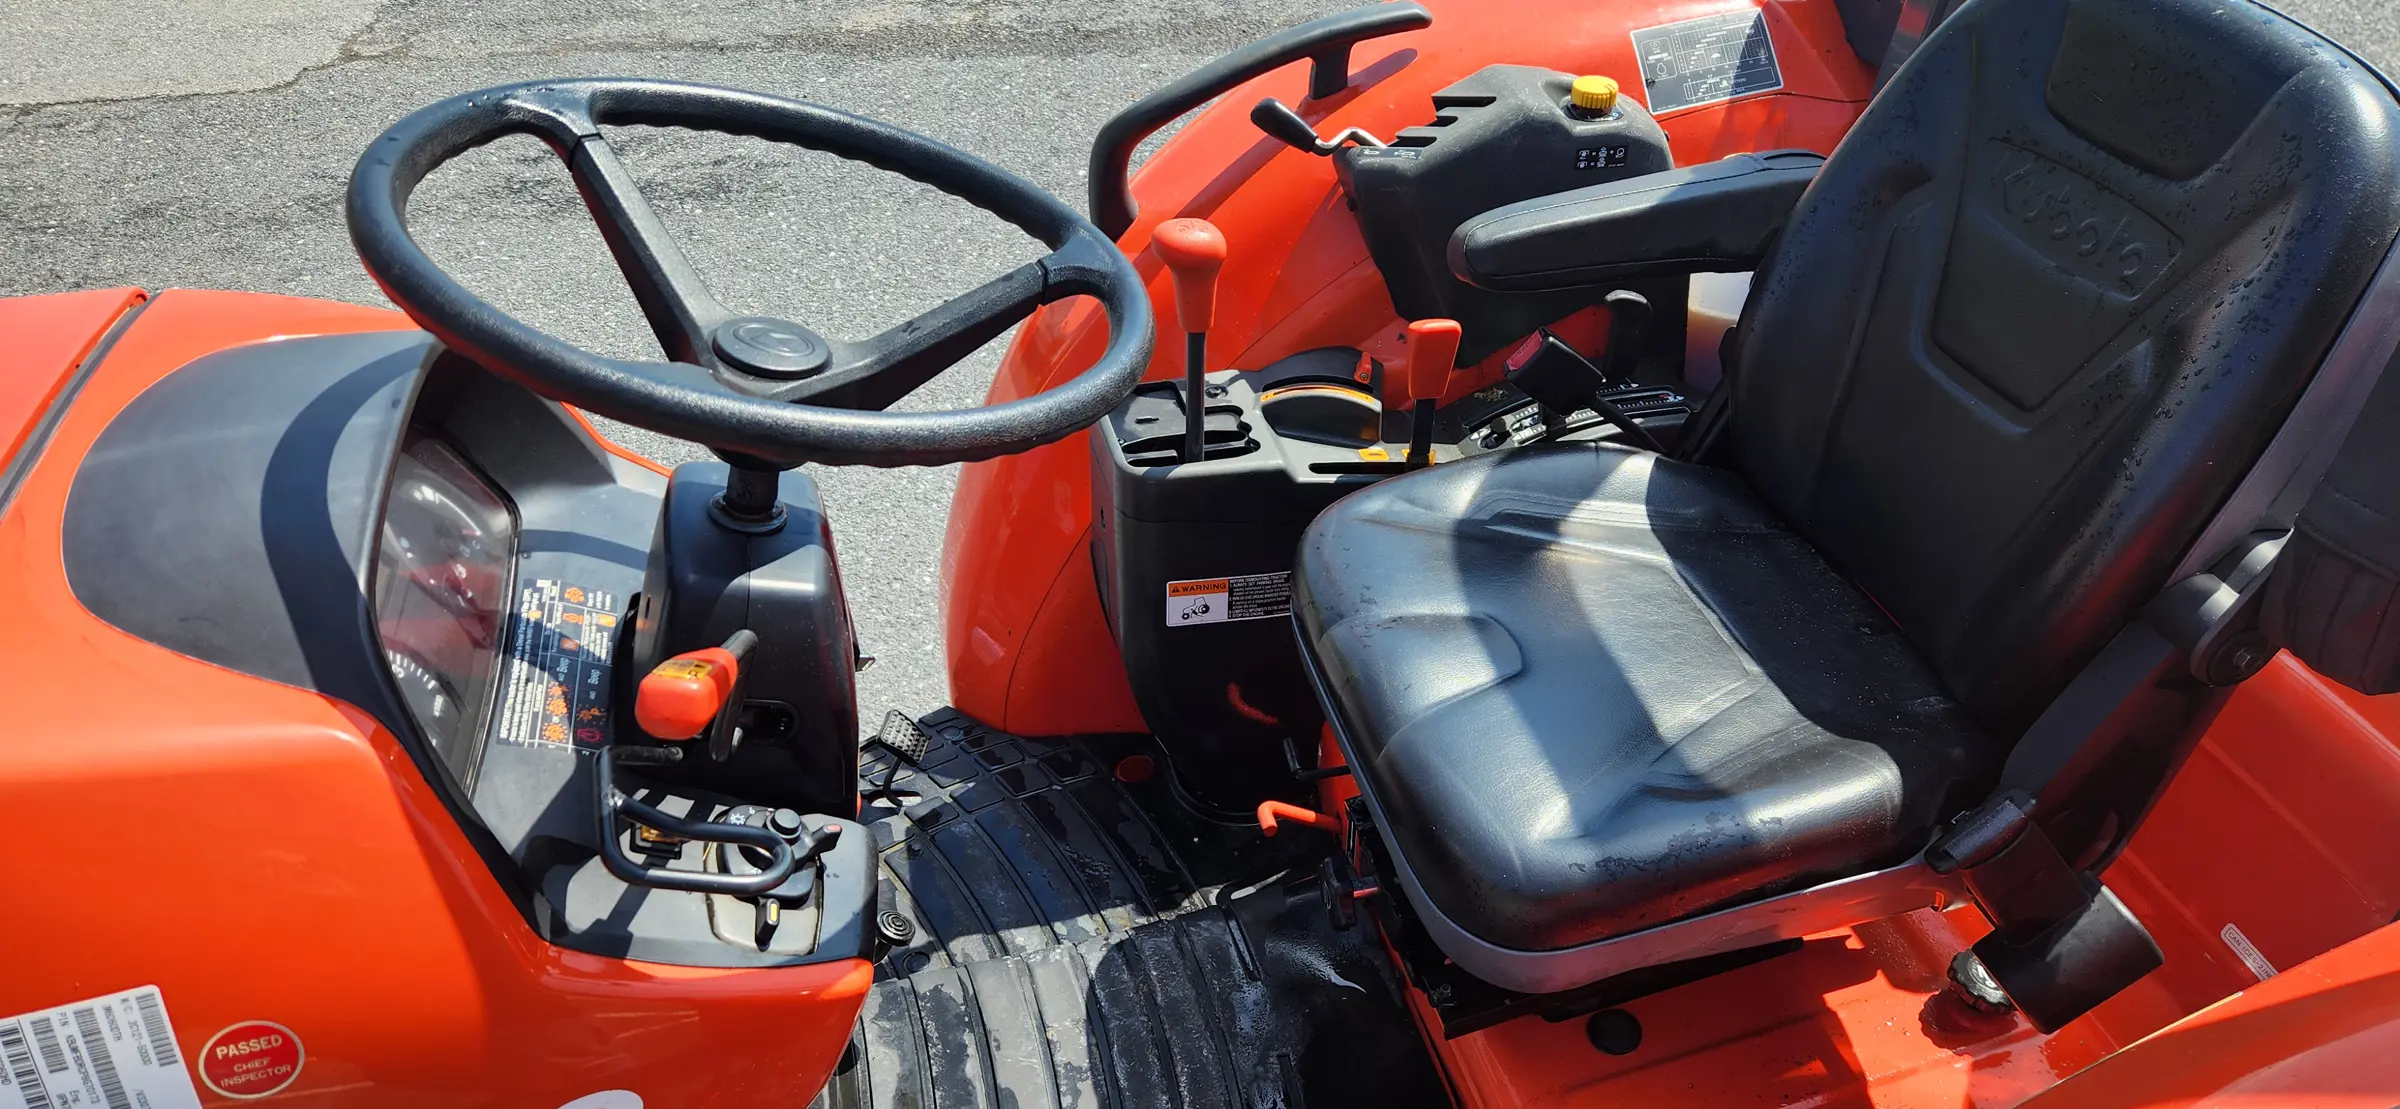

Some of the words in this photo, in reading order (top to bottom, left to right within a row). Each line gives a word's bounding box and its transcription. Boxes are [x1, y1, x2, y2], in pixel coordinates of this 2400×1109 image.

[1182, 582, 1226, 592] WARNING
[556, 657, 571, 673] Beep
[588, 668, 602, 685] Beep
[2228, 931, 2241, 947] CAN
[216, 1033, 283, 1060] PASSED
[233, 1056, 272, 1073] CHIEF
[220, 1064, 292, 1088] INSPECTOR
